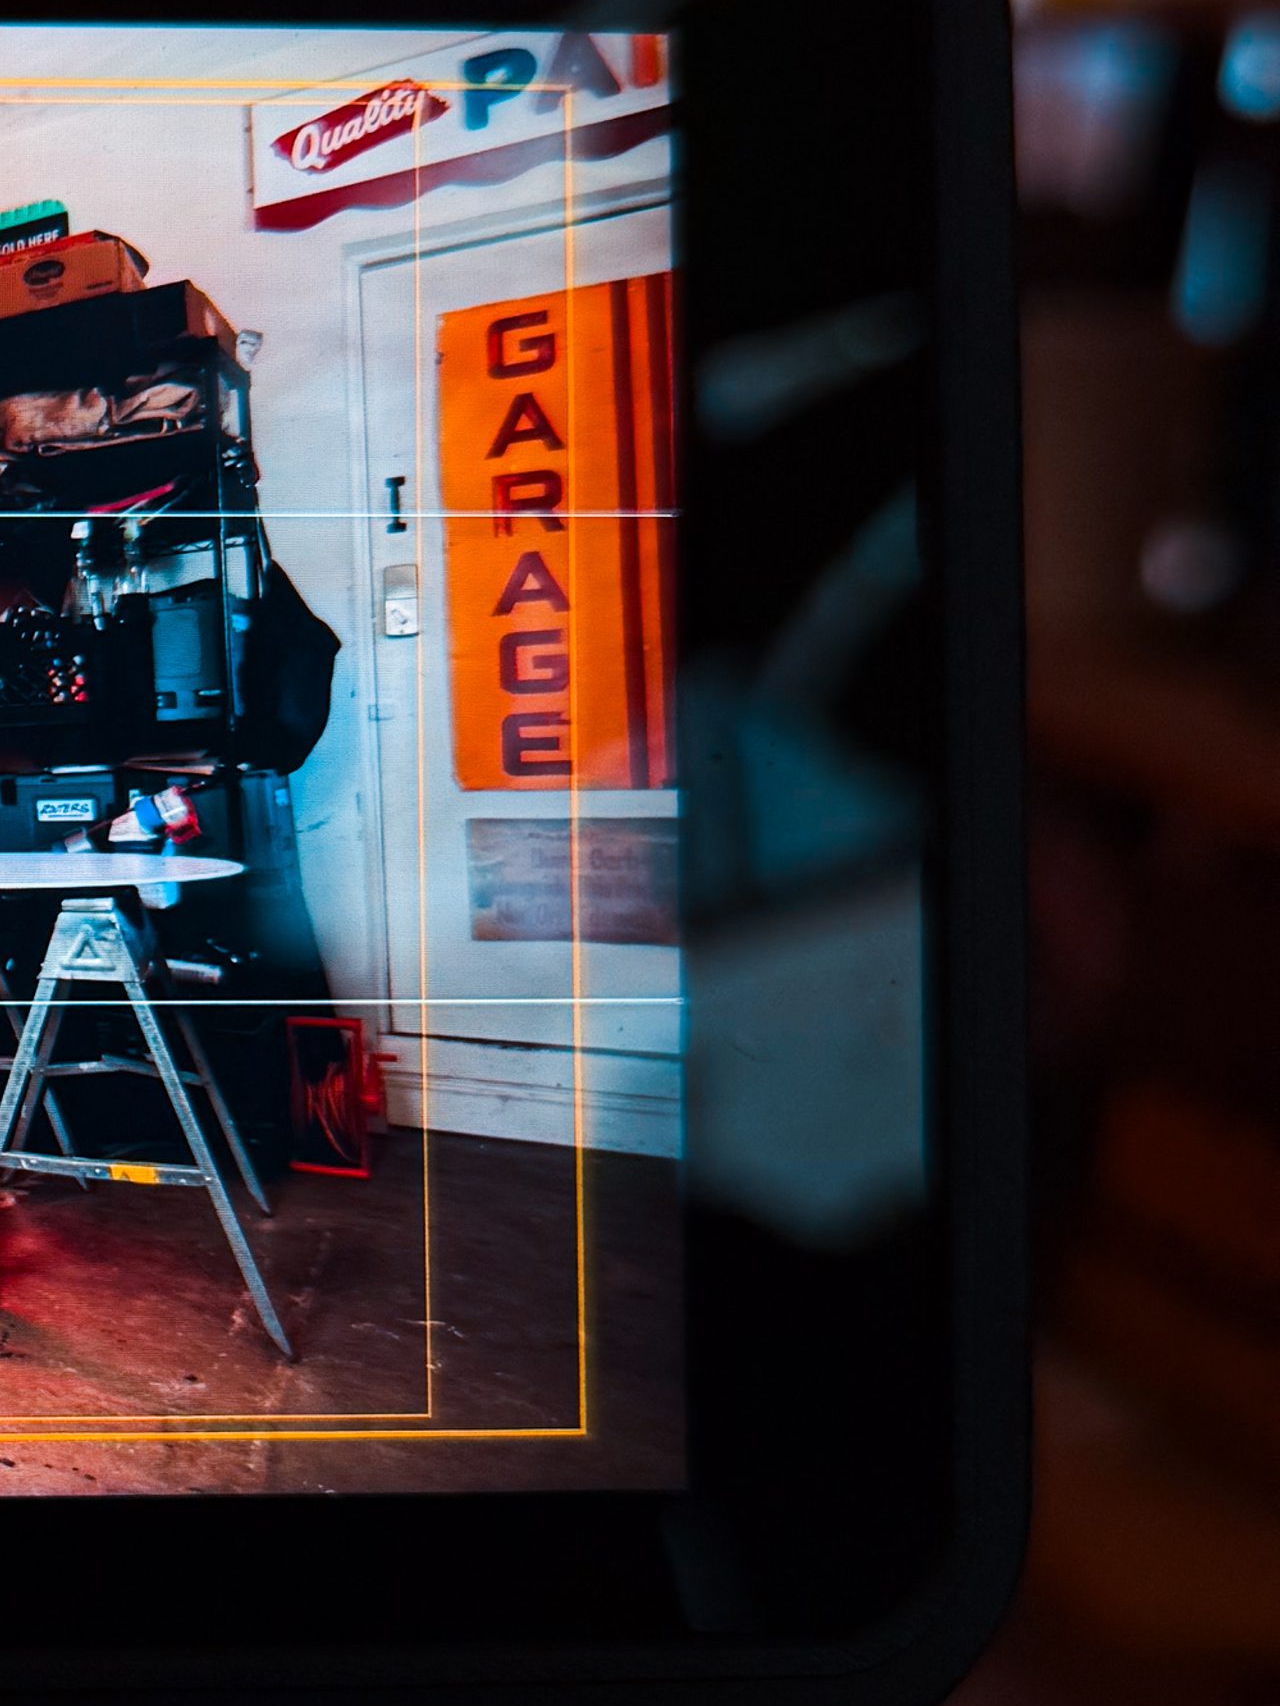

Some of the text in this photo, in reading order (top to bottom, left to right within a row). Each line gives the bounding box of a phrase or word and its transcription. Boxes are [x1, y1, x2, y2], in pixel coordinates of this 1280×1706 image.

[291, 85, 426, 171] Quality
[29, 229, 60, 250] HERE
[485, 310, 572, 778] GARAGE
